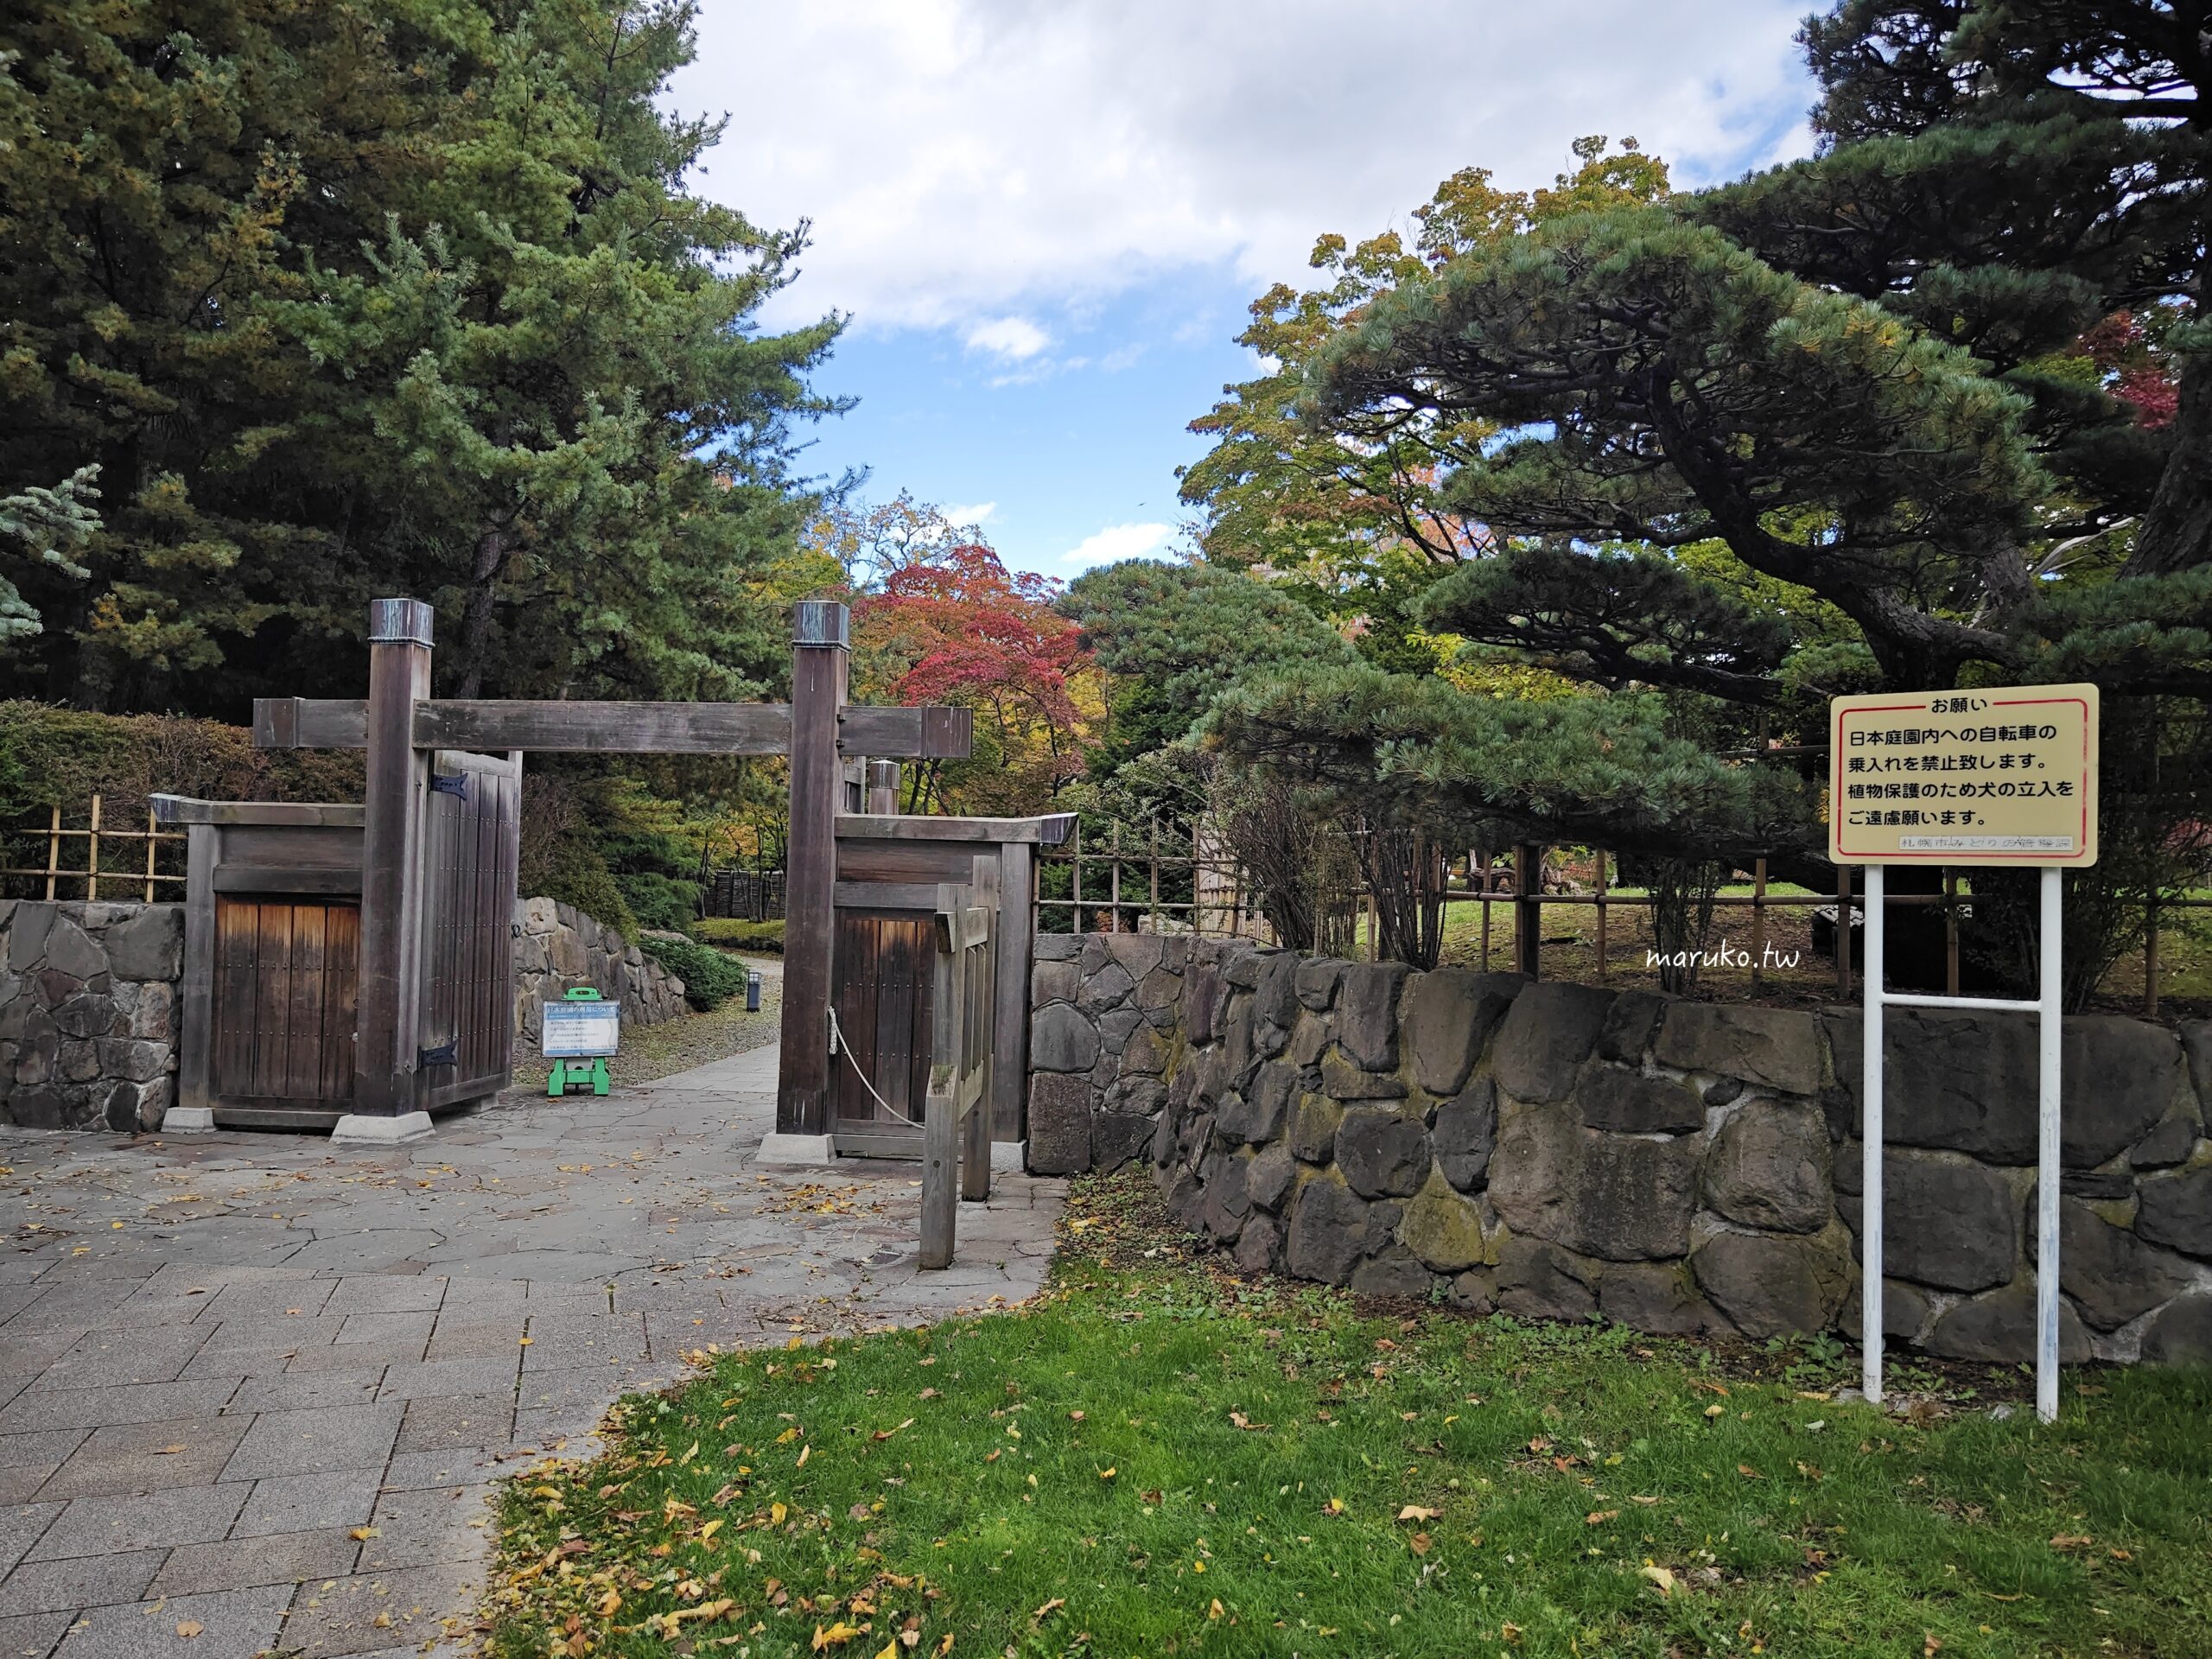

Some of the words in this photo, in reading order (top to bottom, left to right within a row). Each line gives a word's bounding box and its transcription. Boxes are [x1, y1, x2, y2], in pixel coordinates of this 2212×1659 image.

[1931, 697, 1987, 714] お願い
[1850, 724, 2057, 747] 日本庭園内への自転車の
[1848, 753, 2045, 773] 乗入れを禁止致します。
[1847, 780, 2074, 799] 植物保護のため犬の立入を
[1848, 810, 1986, 826] ご遠慮願います。
